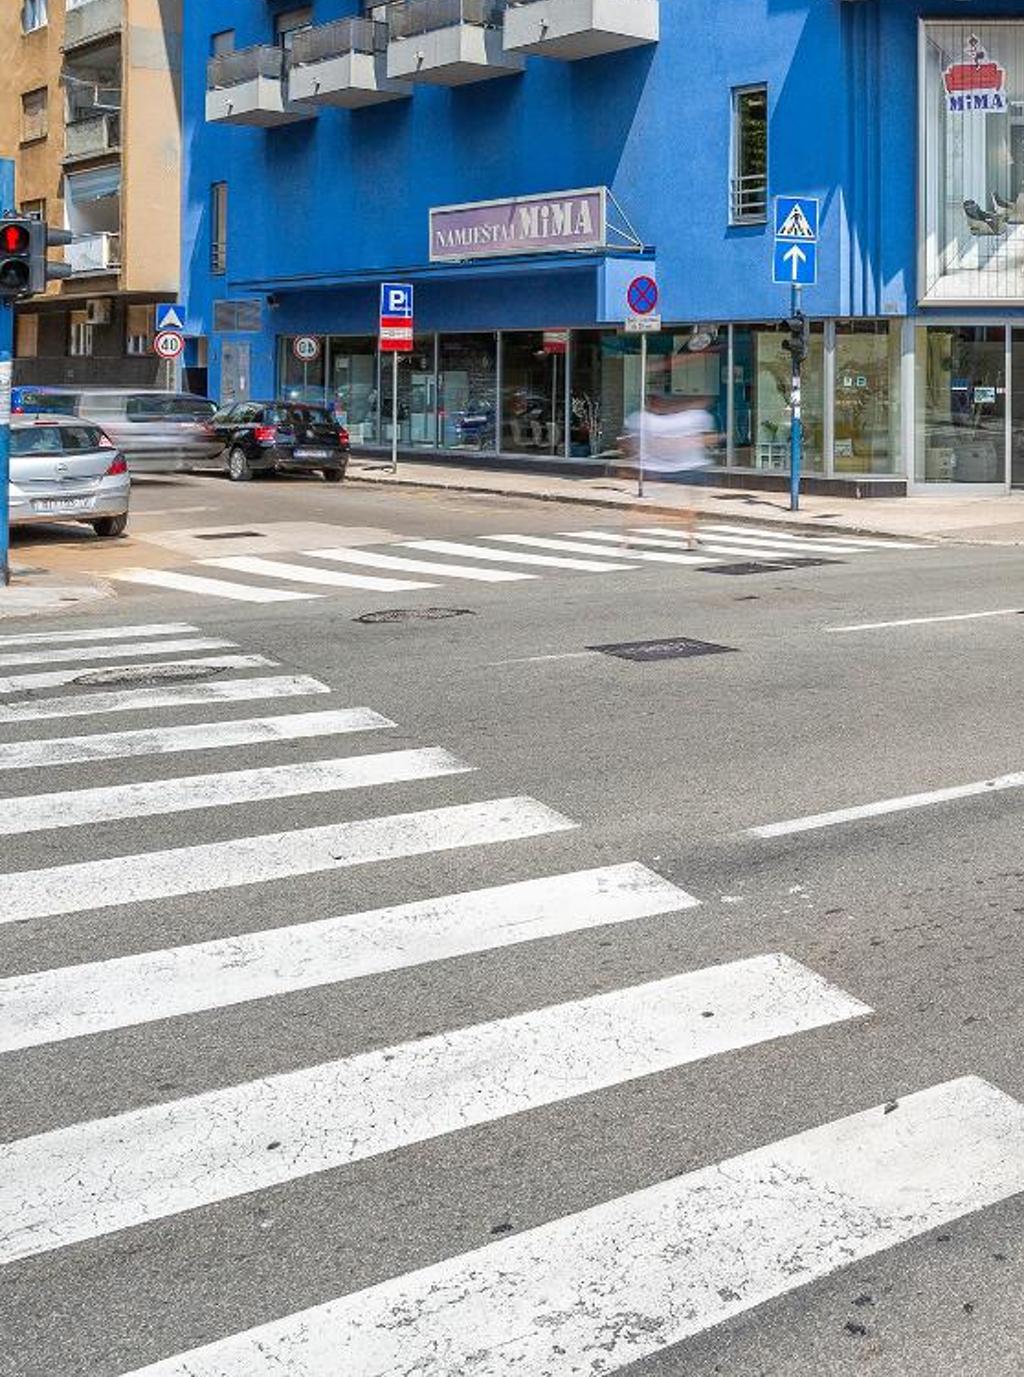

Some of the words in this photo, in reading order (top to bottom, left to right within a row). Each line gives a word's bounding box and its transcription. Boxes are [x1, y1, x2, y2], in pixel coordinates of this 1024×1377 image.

[436, 223, 515, 248] NAMJEŠTAJ
[518, 199, 593, 240] MiMA
[160, 338, 179, 352] 40
